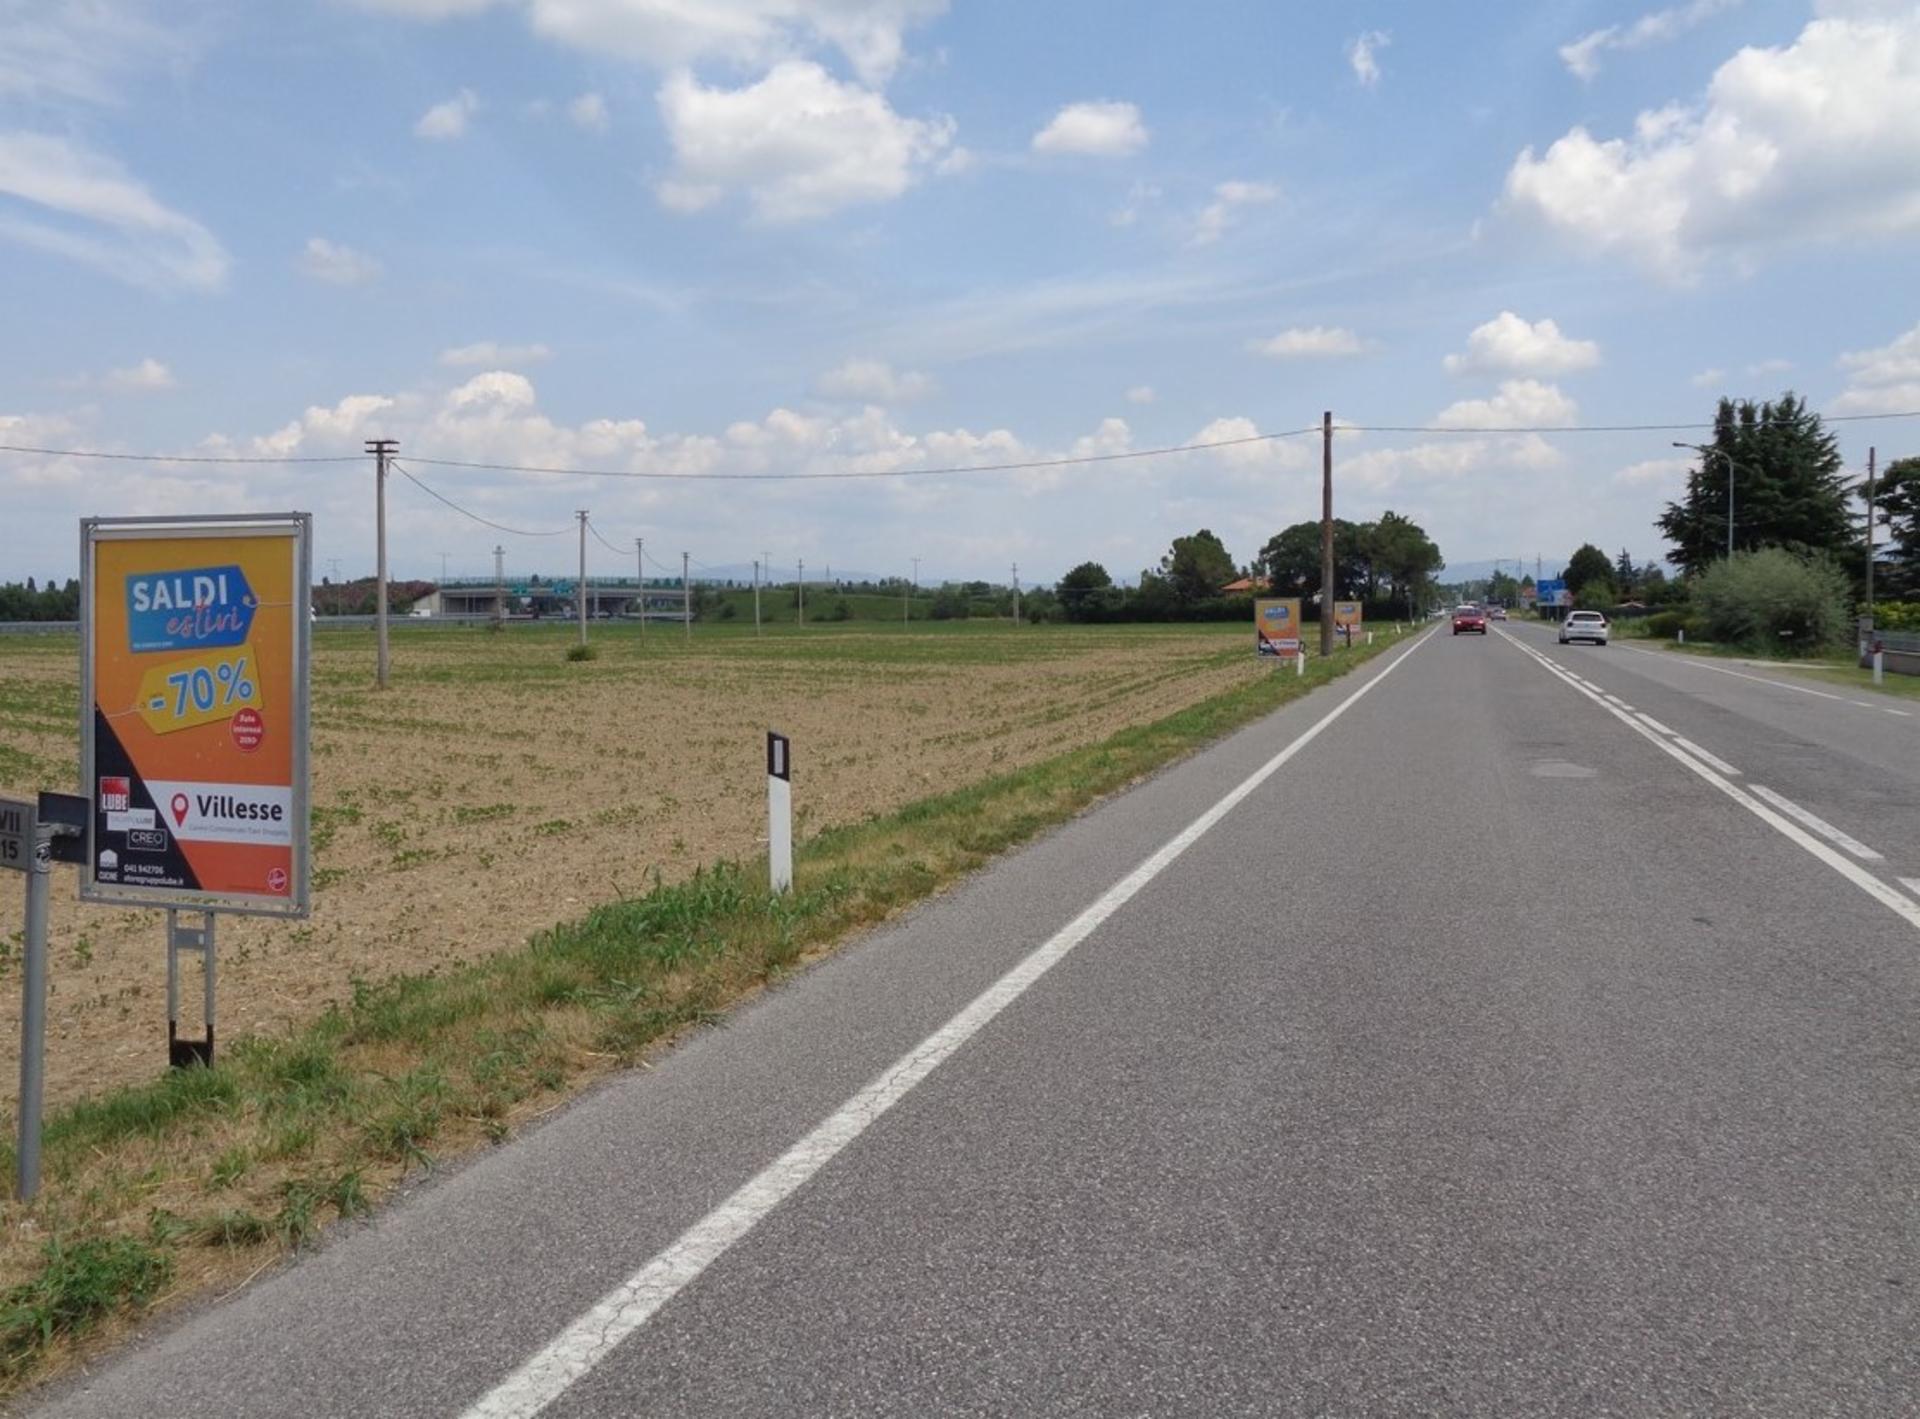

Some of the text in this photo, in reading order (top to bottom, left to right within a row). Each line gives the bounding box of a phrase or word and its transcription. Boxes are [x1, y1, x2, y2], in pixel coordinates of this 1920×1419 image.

[133, 575, 228, 612] SALDI
[150, 657, 255, 716] -70%
[102, 793, 128, 810] LUBE
[196, 795, 283, 821] Villesse
[2, 839, 18, 860] 15
[131, 831, 163, 845] CREO
